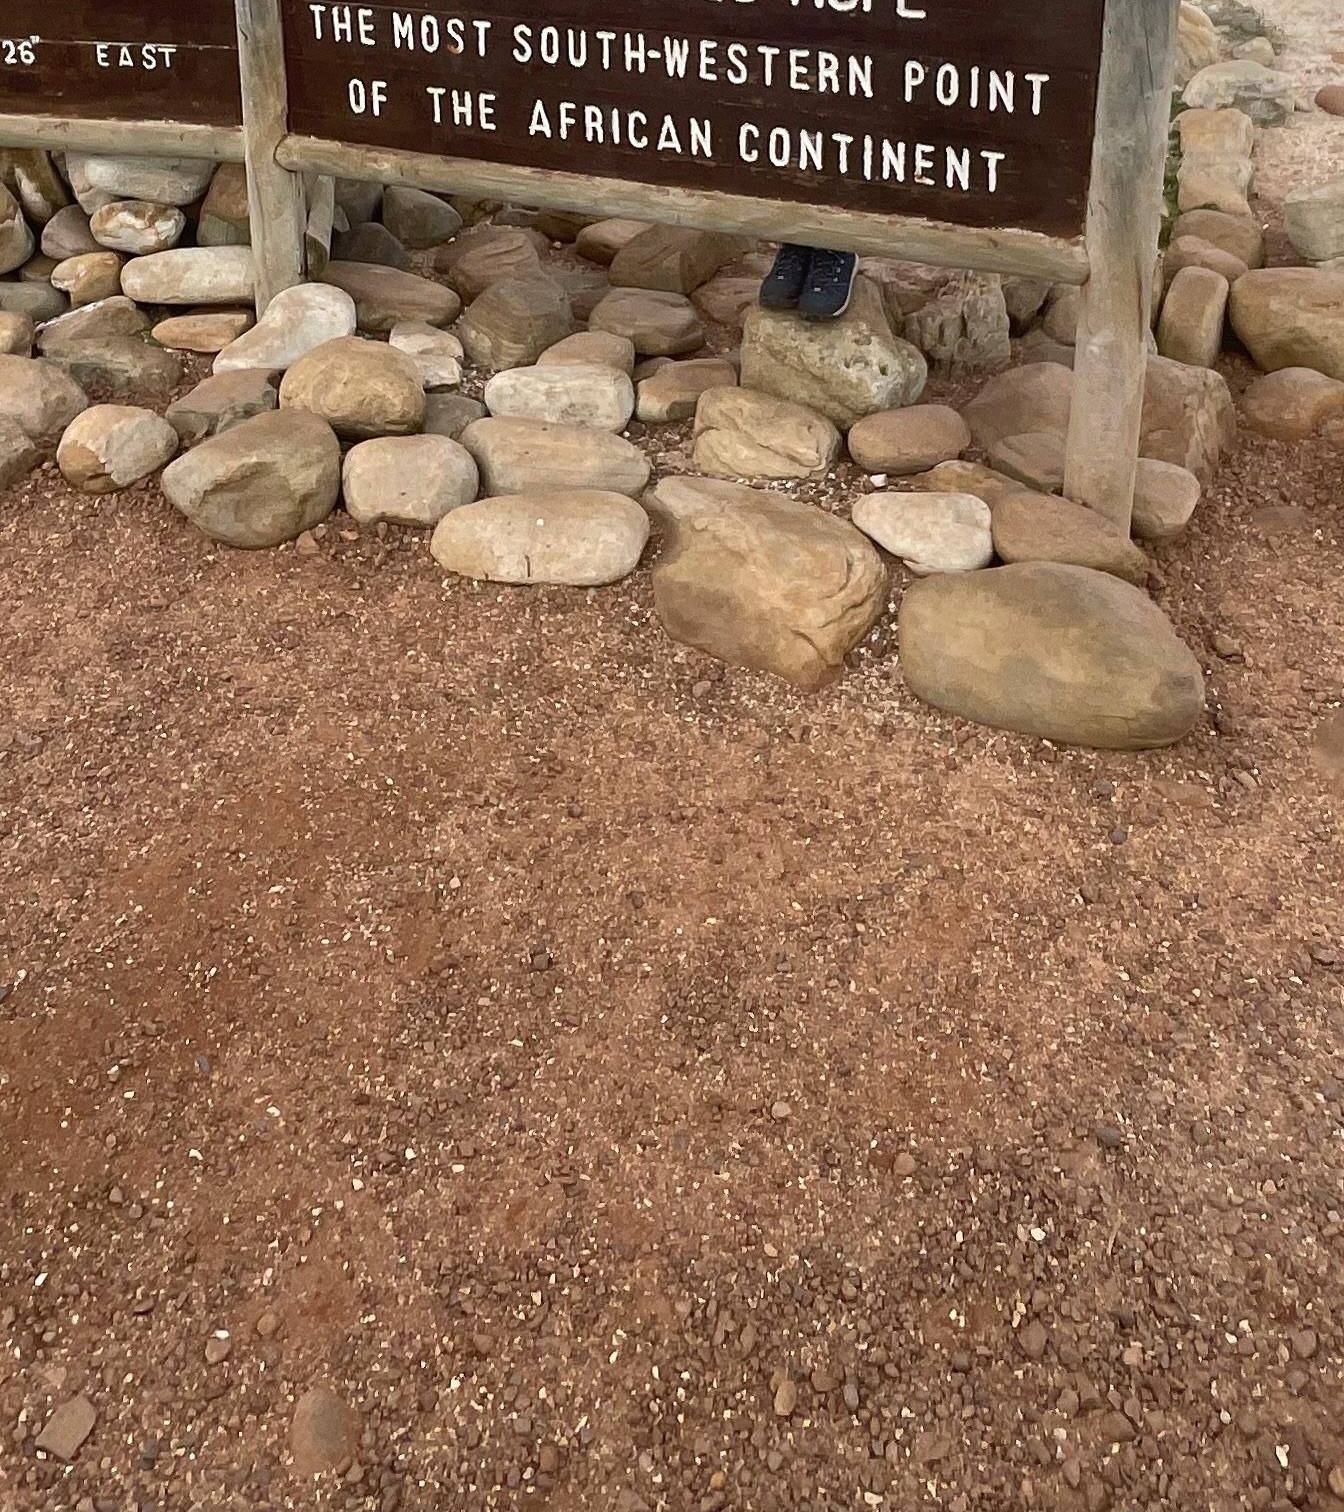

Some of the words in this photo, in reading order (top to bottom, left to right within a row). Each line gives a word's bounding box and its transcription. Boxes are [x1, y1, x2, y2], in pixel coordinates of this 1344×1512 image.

[96, 43, 178, 70] EAST
[308, 3, 376, 47] THE
[392, 10, 493, 58] MOST
[511, 23, 875, 99] SOUTH-WESTERN
[903, 59, 1051, 117] POINT
[348, 78, 389, 118] OF
[426, 85, 497, 132] THE
[528, 98, 714, 159] AFRICAN
[738, 121, 1007, 194] CONTINENT
